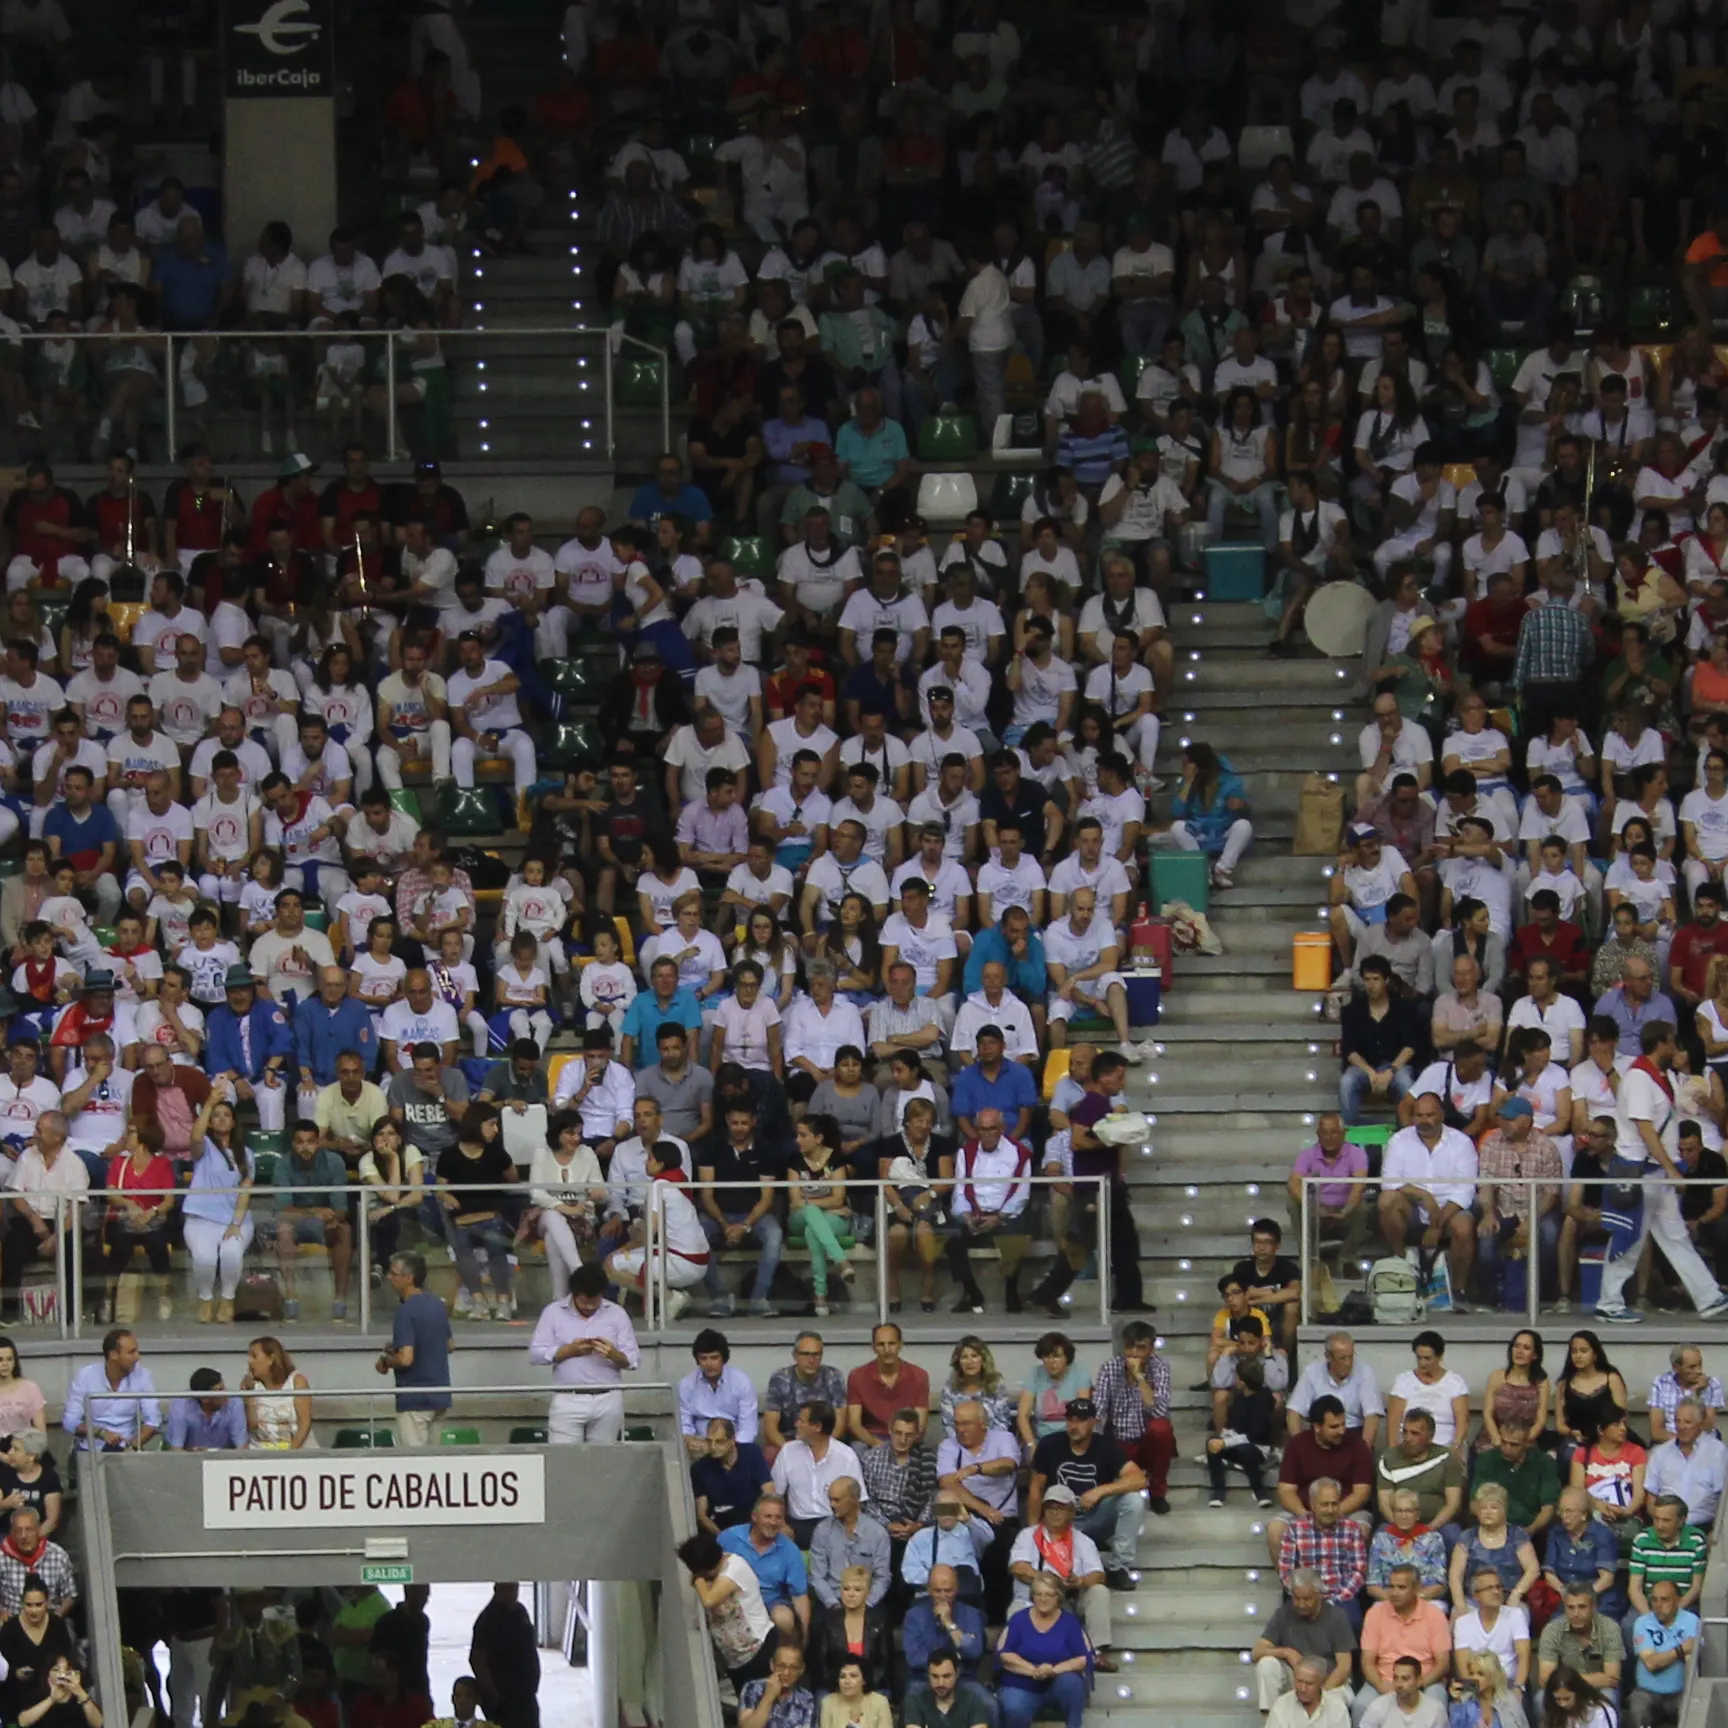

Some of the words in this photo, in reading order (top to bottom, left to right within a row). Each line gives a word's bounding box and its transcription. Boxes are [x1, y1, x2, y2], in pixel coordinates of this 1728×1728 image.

[405, 1103, 450, 1124] REBE
[229, 1476, 307, 1512] PATIO
[319, 1475, 356, 1511] DE
[366, 1472, 519, 1510] CABALLOS
[367, 1568, 407, 1580] SALIDA
